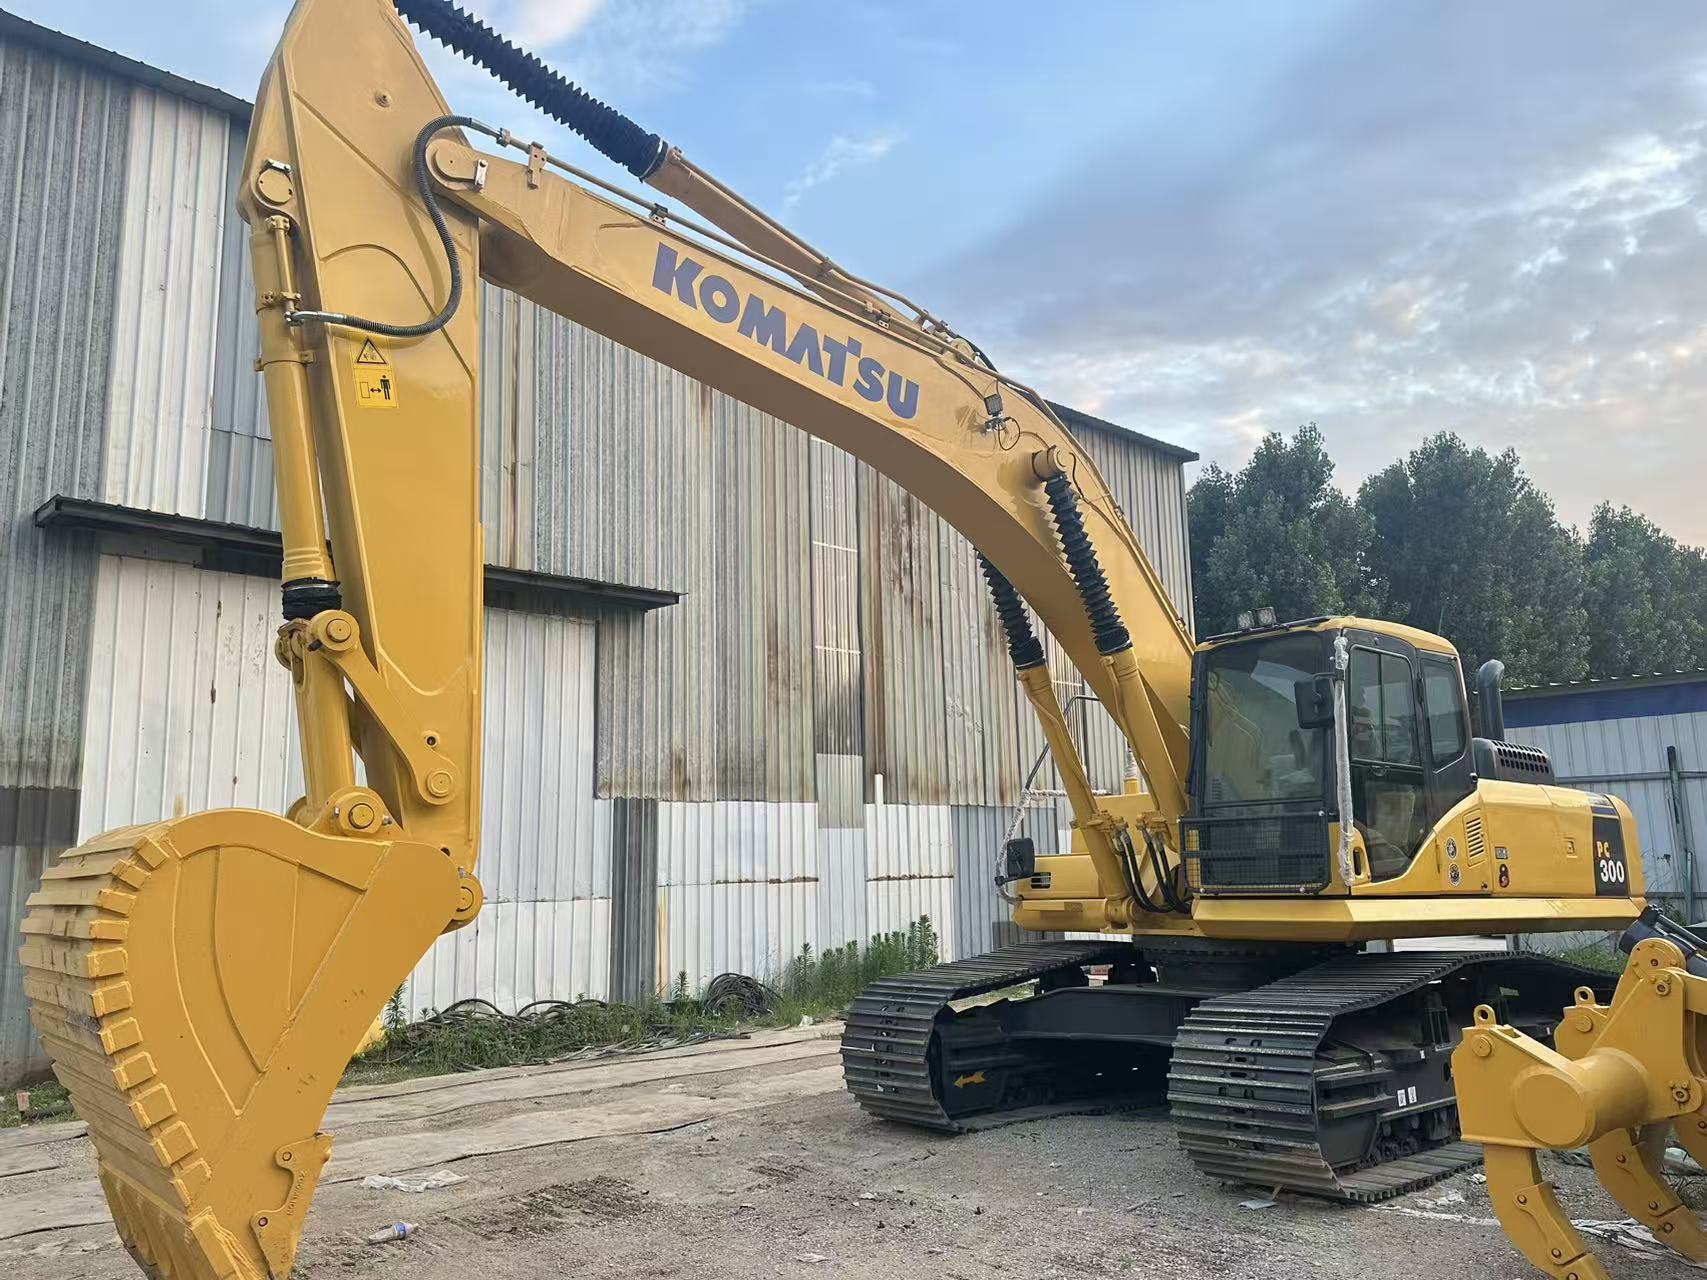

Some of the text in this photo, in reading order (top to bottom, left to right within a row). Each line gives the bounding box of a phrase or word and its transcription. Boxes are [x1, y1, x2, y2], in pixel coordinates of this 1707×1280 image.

[652, 241, 919, 420] KOMATSU
[1596, 840, 1610, 859] PC
[1600, 859, 1625, 883] 300
